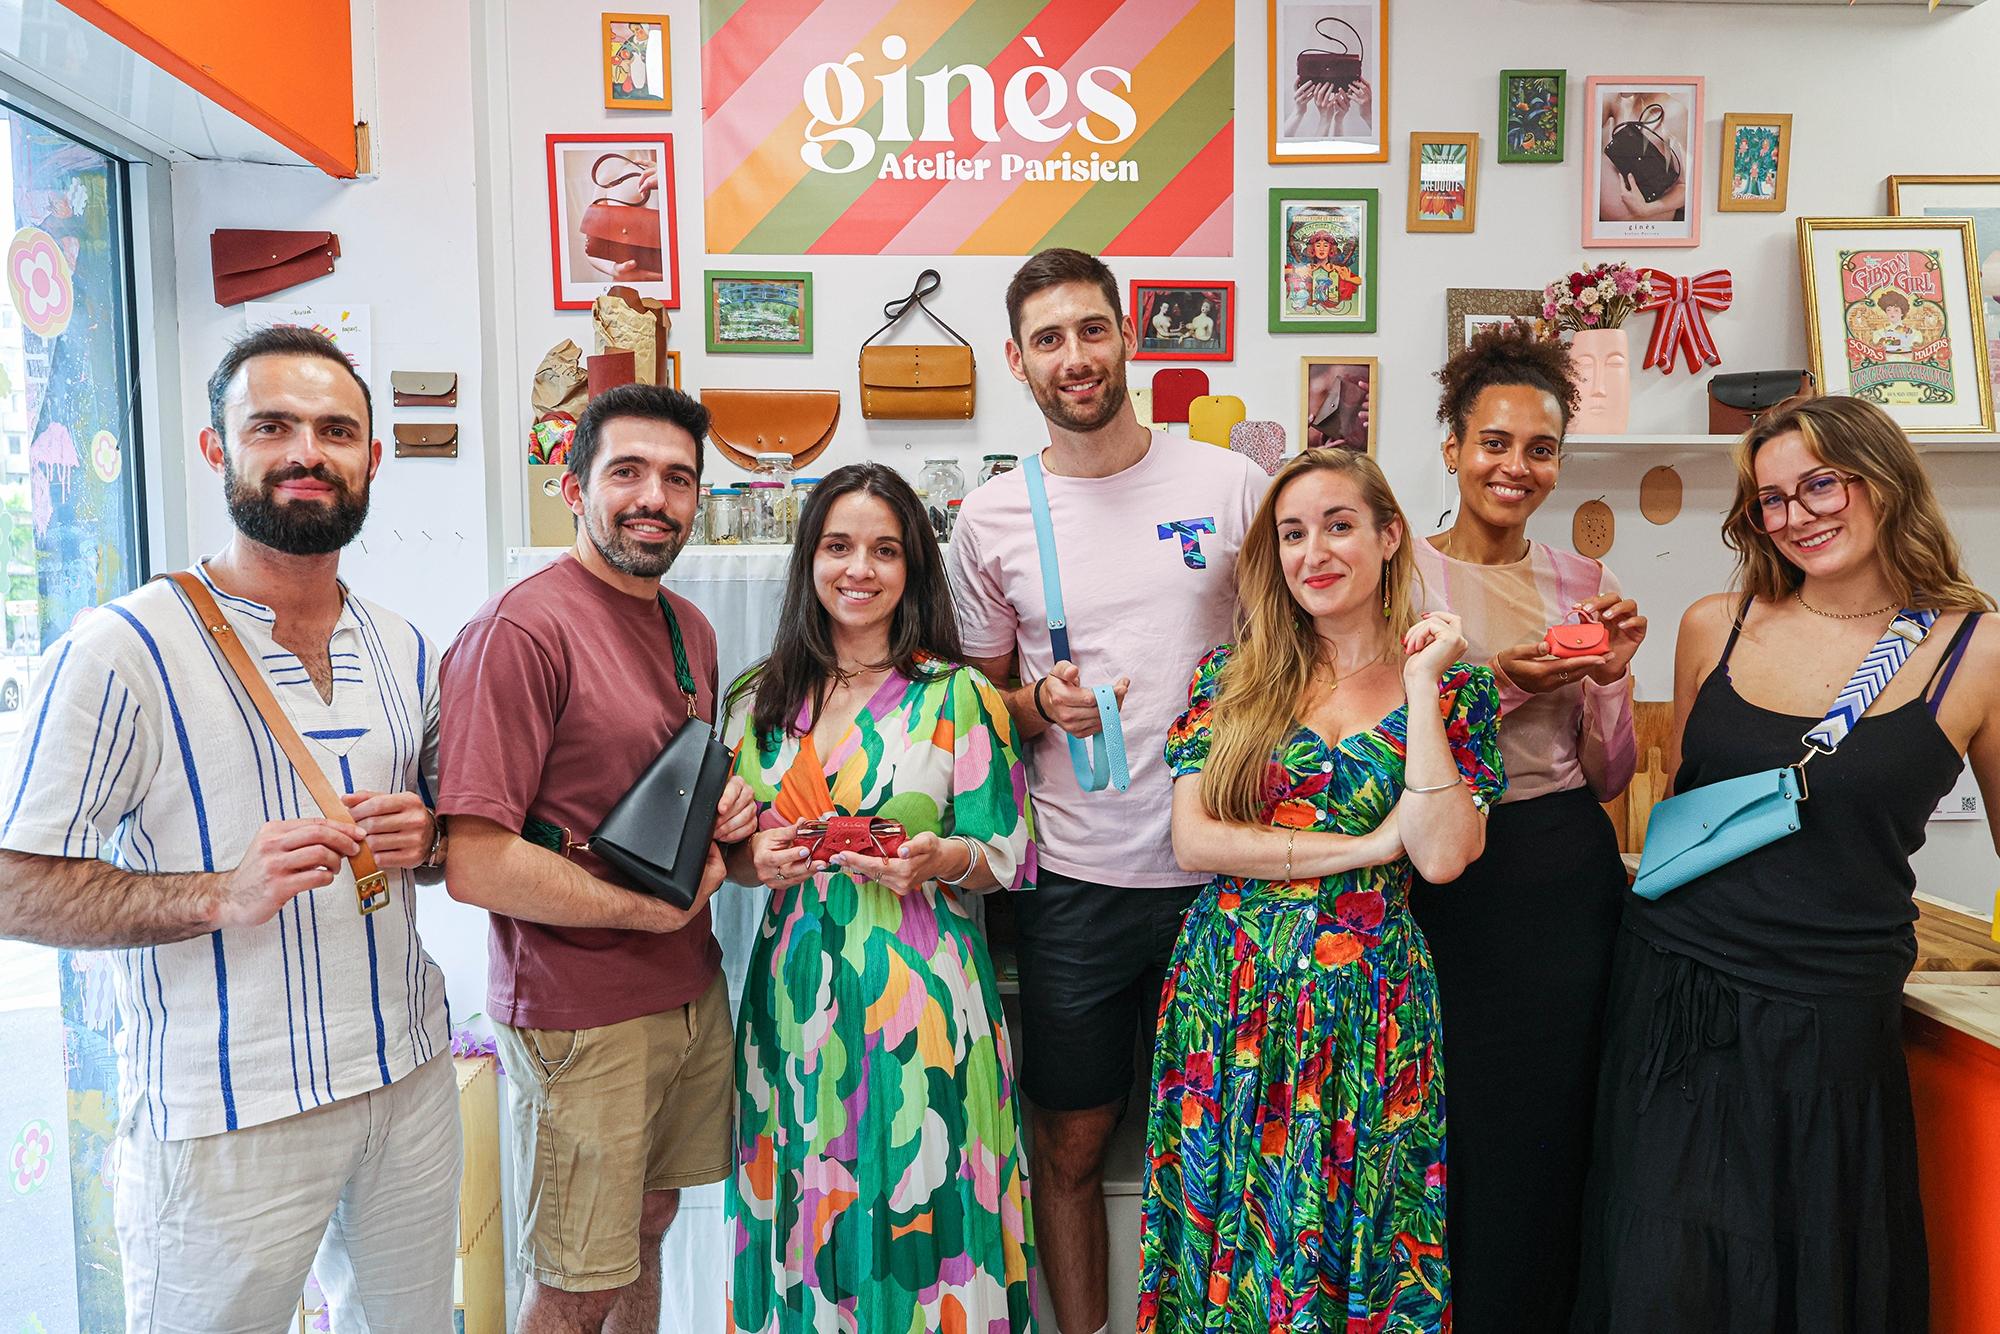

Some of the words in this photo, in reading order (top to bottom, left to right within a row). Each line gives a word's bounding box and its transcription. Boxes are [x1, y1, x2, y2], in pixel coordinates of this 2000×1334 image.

[800, 34, 1138, 174] ginès
[877, 150, 992, 181] Atelier
[1000, 151, 1140, 182] Parisien
[1852, 253, 1909, 294] GIBSON
[1893, 270, 1935, 297] GIRL
[1849, 339, 1884, 360] SODAS
[1914, 339, 1949, 360] MALTEDS
